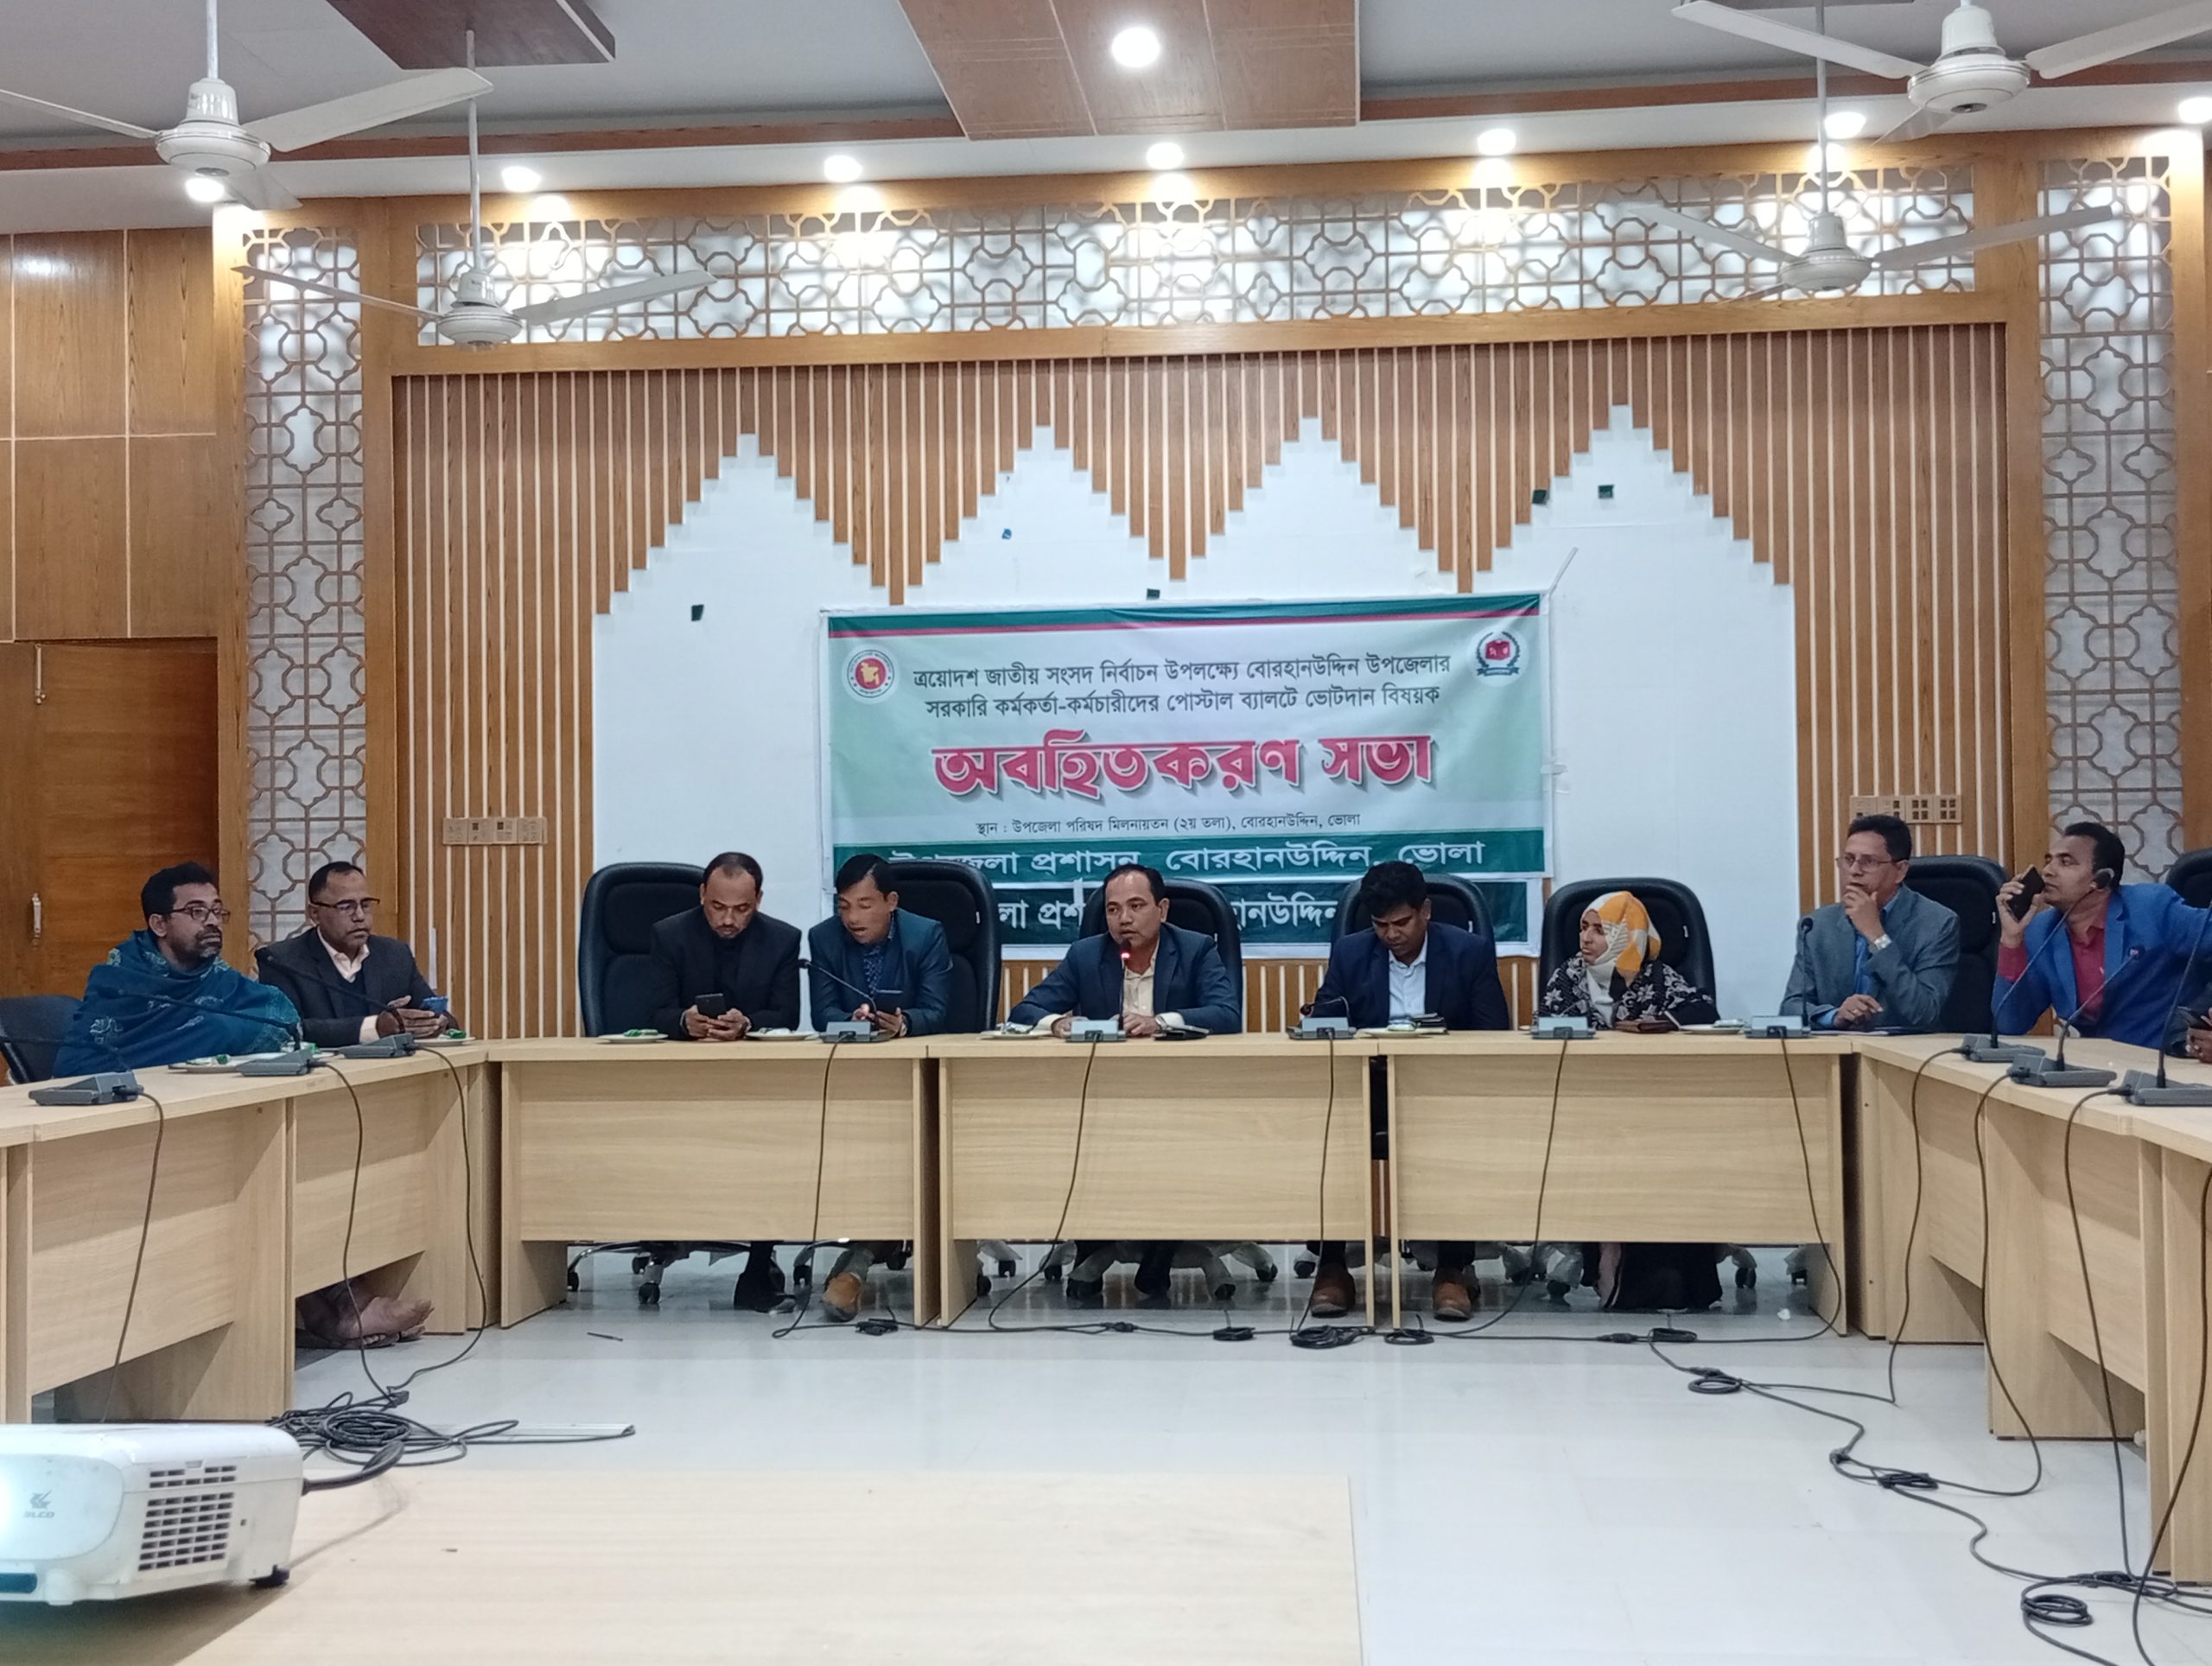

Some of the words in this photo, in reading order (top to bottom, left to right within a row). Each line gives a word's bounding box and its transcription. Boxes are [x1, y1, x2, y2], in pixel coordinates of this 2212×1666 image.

[912, 668, 978, 689] ত্রয়োদশ
[985, 662, 1039, 687] জাতীয়
[1045, 666, 1094, 685] সংসদ
[1100, 658, 1159, 684] নির্বাচন
[1163, 658, 1239, 681] উপলক্ষ্যে
[1246, 653, 1360, 680] বোরহানউদ্দিন
[1365, 652, 1452, 676] উপজেলার
[925, 694, 988, 718] সরকারি
[993, 689, 1160, 716] কর্মকর্তা-কর্মচারীদের
[1166, 687, 1234, 712] পোস্টাল
[1239, 687, 1299, 711] ব্যালটে
[1305, 684, 1376, 709] ভোটদান
[1382, 682, 1441, 706] বিষয়ক
[931, 728, 1299, 799] অবহিতকরণ
[1317, 734, 1434, 785] সভা
[1012, 818, 1061, 834] উপজেলা
[1065, 817, 1103, 833] পরিষদ
[1107, 816, 1169, 832] মিলনায়তন
[1327, 813, 1362, 828] ভোলা
[1398, 840, 1486, 865] ভোলা
